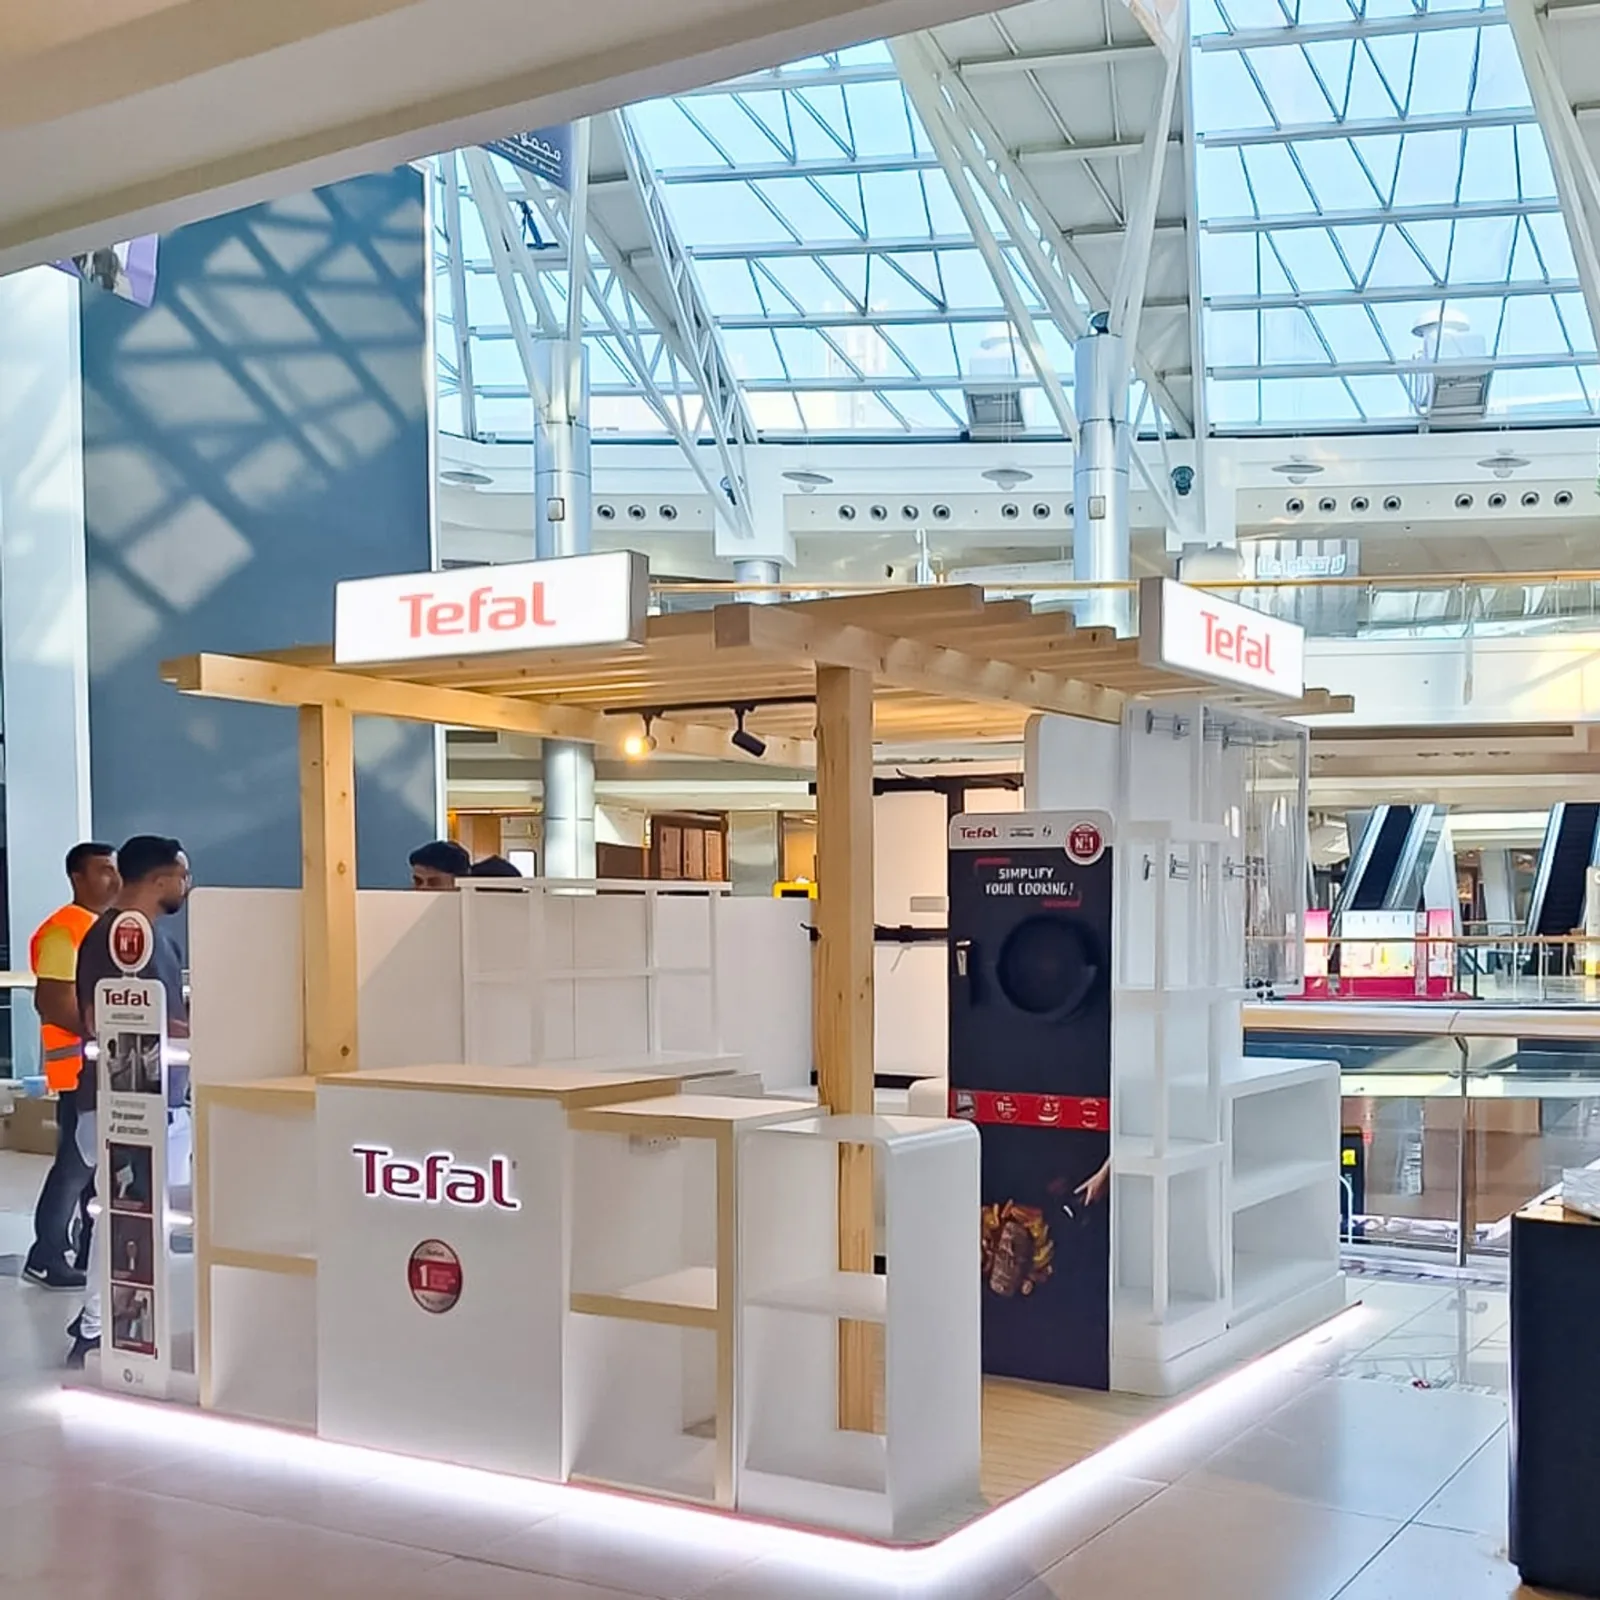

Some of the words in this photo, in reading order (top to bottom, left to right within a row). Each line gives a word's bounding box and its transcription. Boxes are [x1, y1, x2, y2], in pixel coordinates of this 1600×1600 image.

[399, 582, 557, 638] Tefal
[1200, 610, 1275, 675] Tefal
[959, 827, 999, 839] Tefal
[998, 867, 1054, 880] SIMPLIFY
[985, 882, 1014, 896] YOUR
[1018, 882, 1074, 897] COOKING!
[103, 988, 151, 1007] Tefal
[351, 1146, 518, 1210] Tefal
